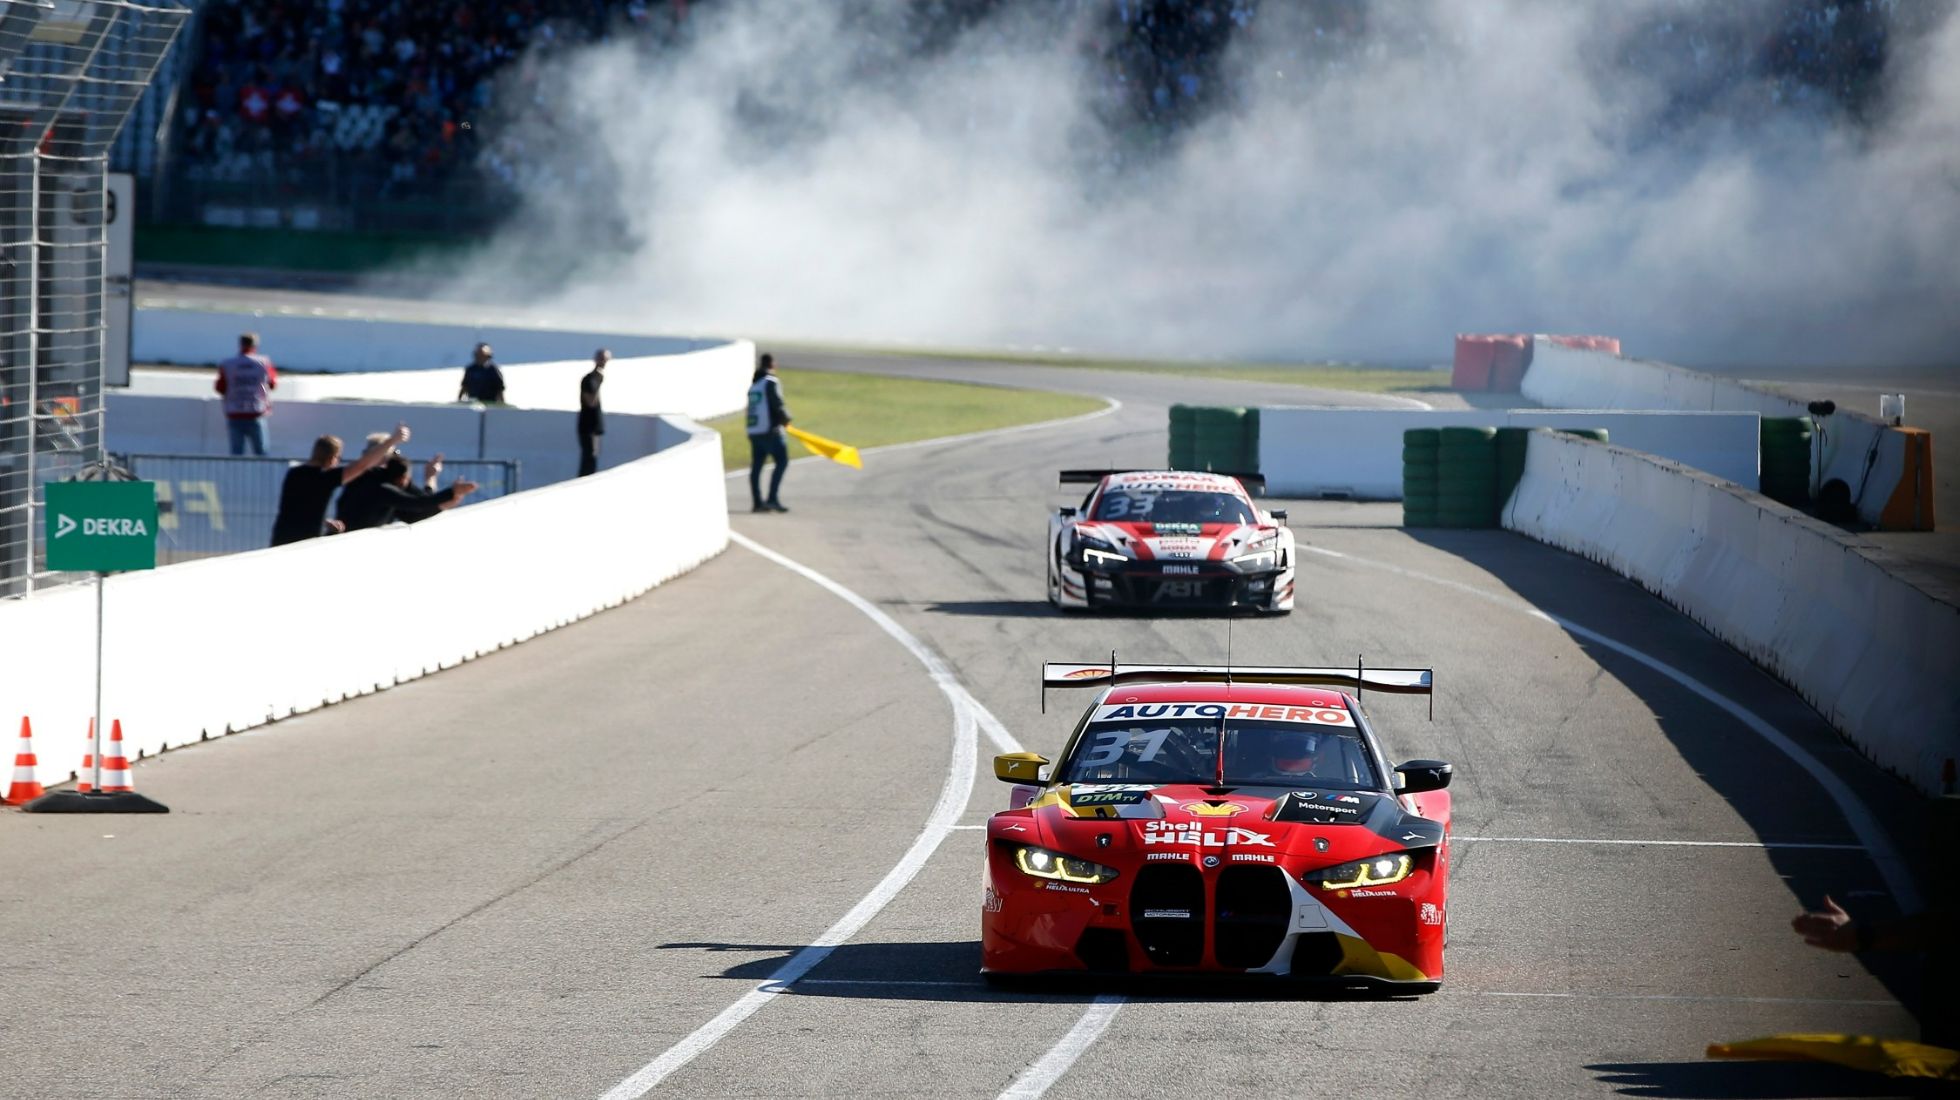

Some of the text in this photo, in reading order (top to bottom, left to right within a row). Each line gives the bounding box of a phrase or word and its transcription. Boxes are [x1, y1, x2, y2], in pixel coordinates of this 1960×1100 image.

[1122, 475, 1213, 483] SONAX
[1111, 482, 1237, 492] AUTOHERO
[1106, 494, 1154, 519] 33
[83, 518, 147, 536] DEKRA
[1155, 523, 1199, 531] DEKRA
[1162, 565, 1200, 575] MAHLE
[1152, 581, 1209, 603] ABT
[1102, 704, 1347, 724] AUTOHERO
[1079, 729, 1172, 768] 31
[1076, 792, 1123, 803] DTM
[1299, 802, 1358, 814] Motorsport
[1146, 820, 1202, 831] Shell
[1144, 827, 1276, 847] HELIX
[1232, 854, 1275, 863] MAHLE
